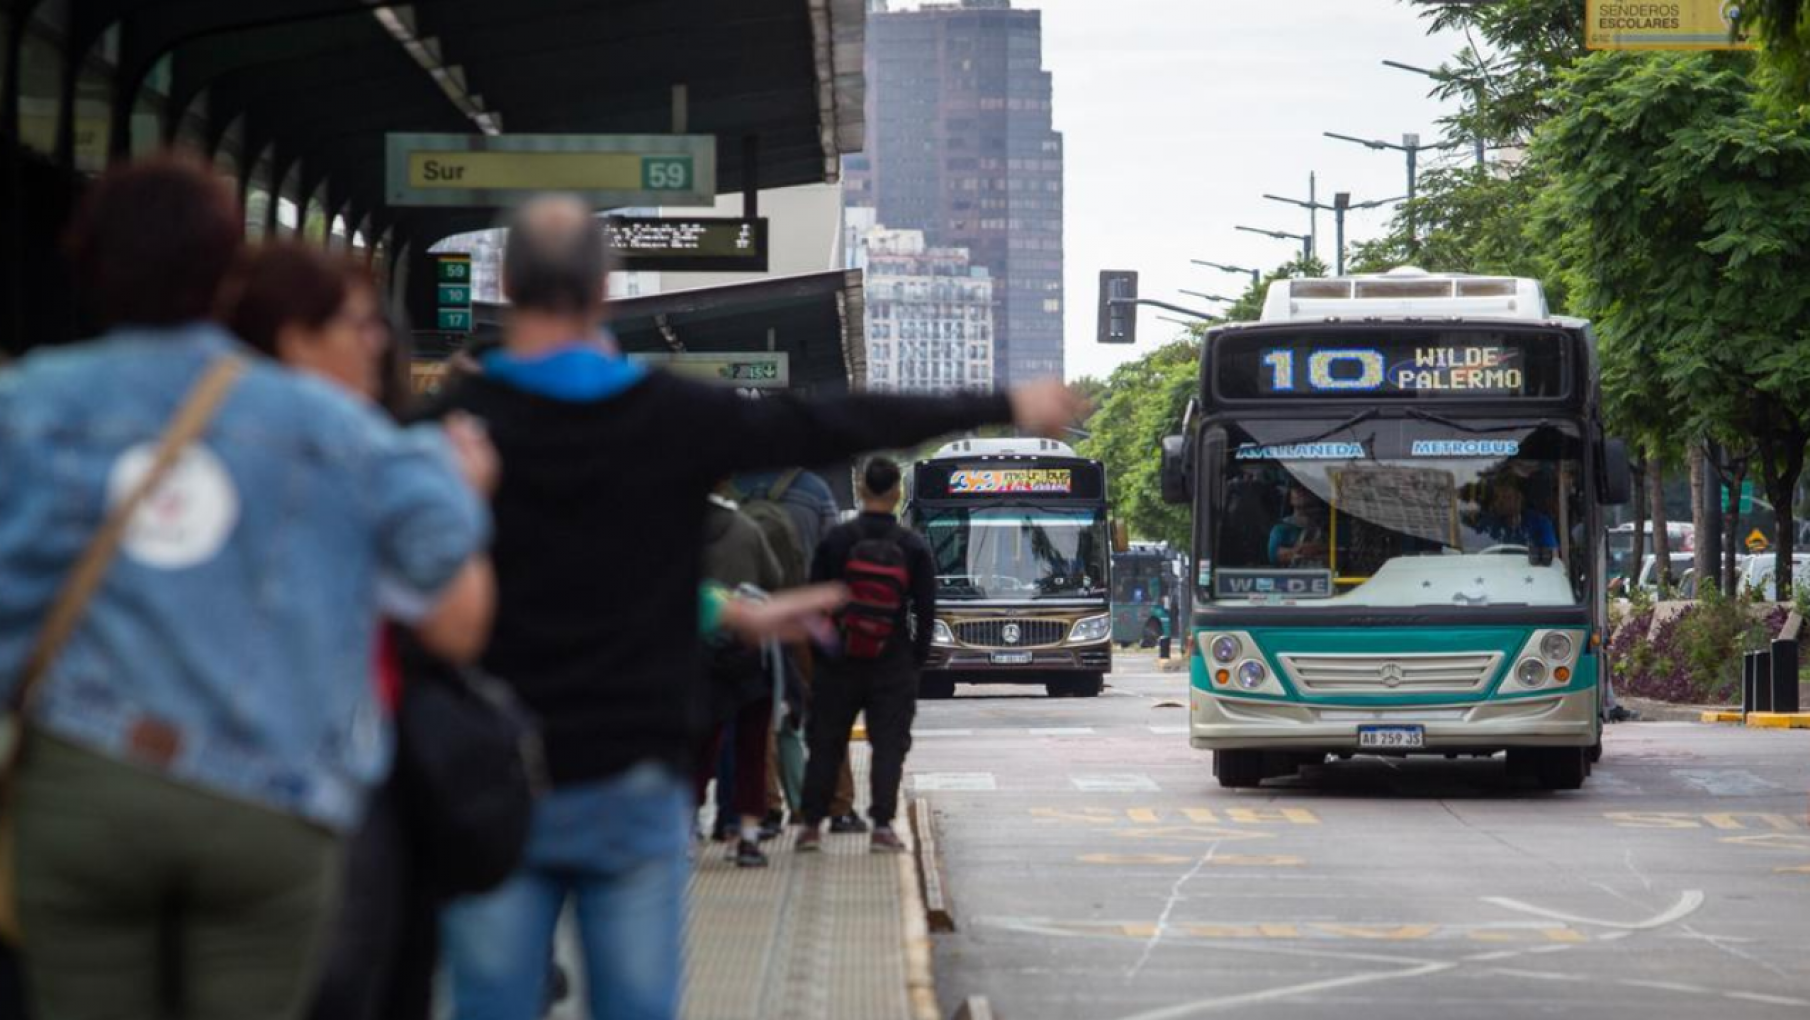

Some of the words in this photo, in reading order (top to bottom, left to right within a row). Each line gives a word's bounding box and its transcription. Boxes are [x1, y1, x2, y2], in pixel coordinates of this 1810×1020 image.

[1600, 5, 1679, 17] SENDEROS
[1599, 18, 1679, 29] ESCOLARES
[423, 160, 465, 180] Sur
[649, 162, 685, 188] 59
[447, 264, 464, 277] 59
[449, 289, 463, 301] 10
[449, 313, 463, 327] 17
[1415, 347, 1499, 368] WILDE
[1263, 348, 1385, 391] 10
[1399, 369, 1521, 389] PALERMO
[1411, 440, 1520, 456] METROBUS
[1229, 577, 1327, 593] WLDE
[1362, 733, 1377, 745] AB
[1381, 733, 1403, 745] 259
[1405, 733, 1421, 745] JS
